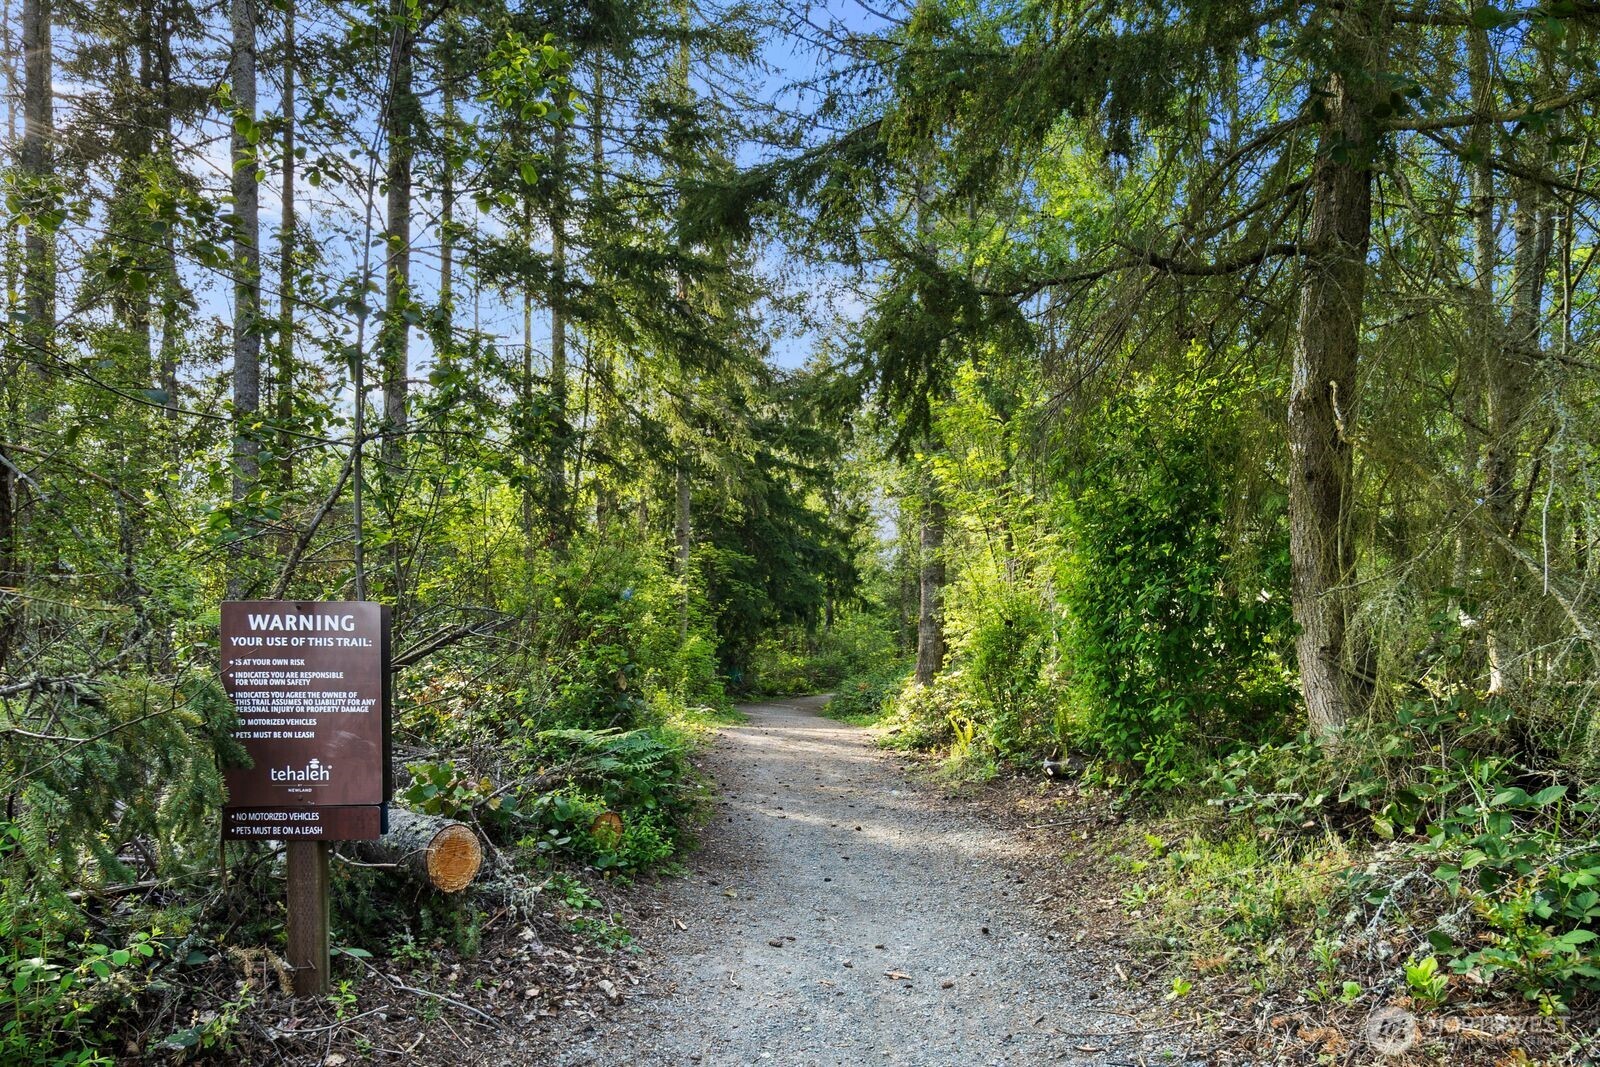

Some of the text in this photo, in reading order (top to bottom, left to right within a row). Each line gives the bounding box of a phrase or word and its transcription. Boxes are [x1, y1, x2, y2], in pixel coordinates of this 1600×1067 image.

[248, 614, 355, 631] WARNING
[230, 636, 373, 646] YOUR USE OF THIS TRAIL:
[270, 706, 295, 714] INJURY
[271, 765, 330, 781] tehaleh
[236, 813, 320, 821] NO MOTORIZED VEHICLES
[236, 826, 323, 834] PETS MUST BE ON A LEASH
